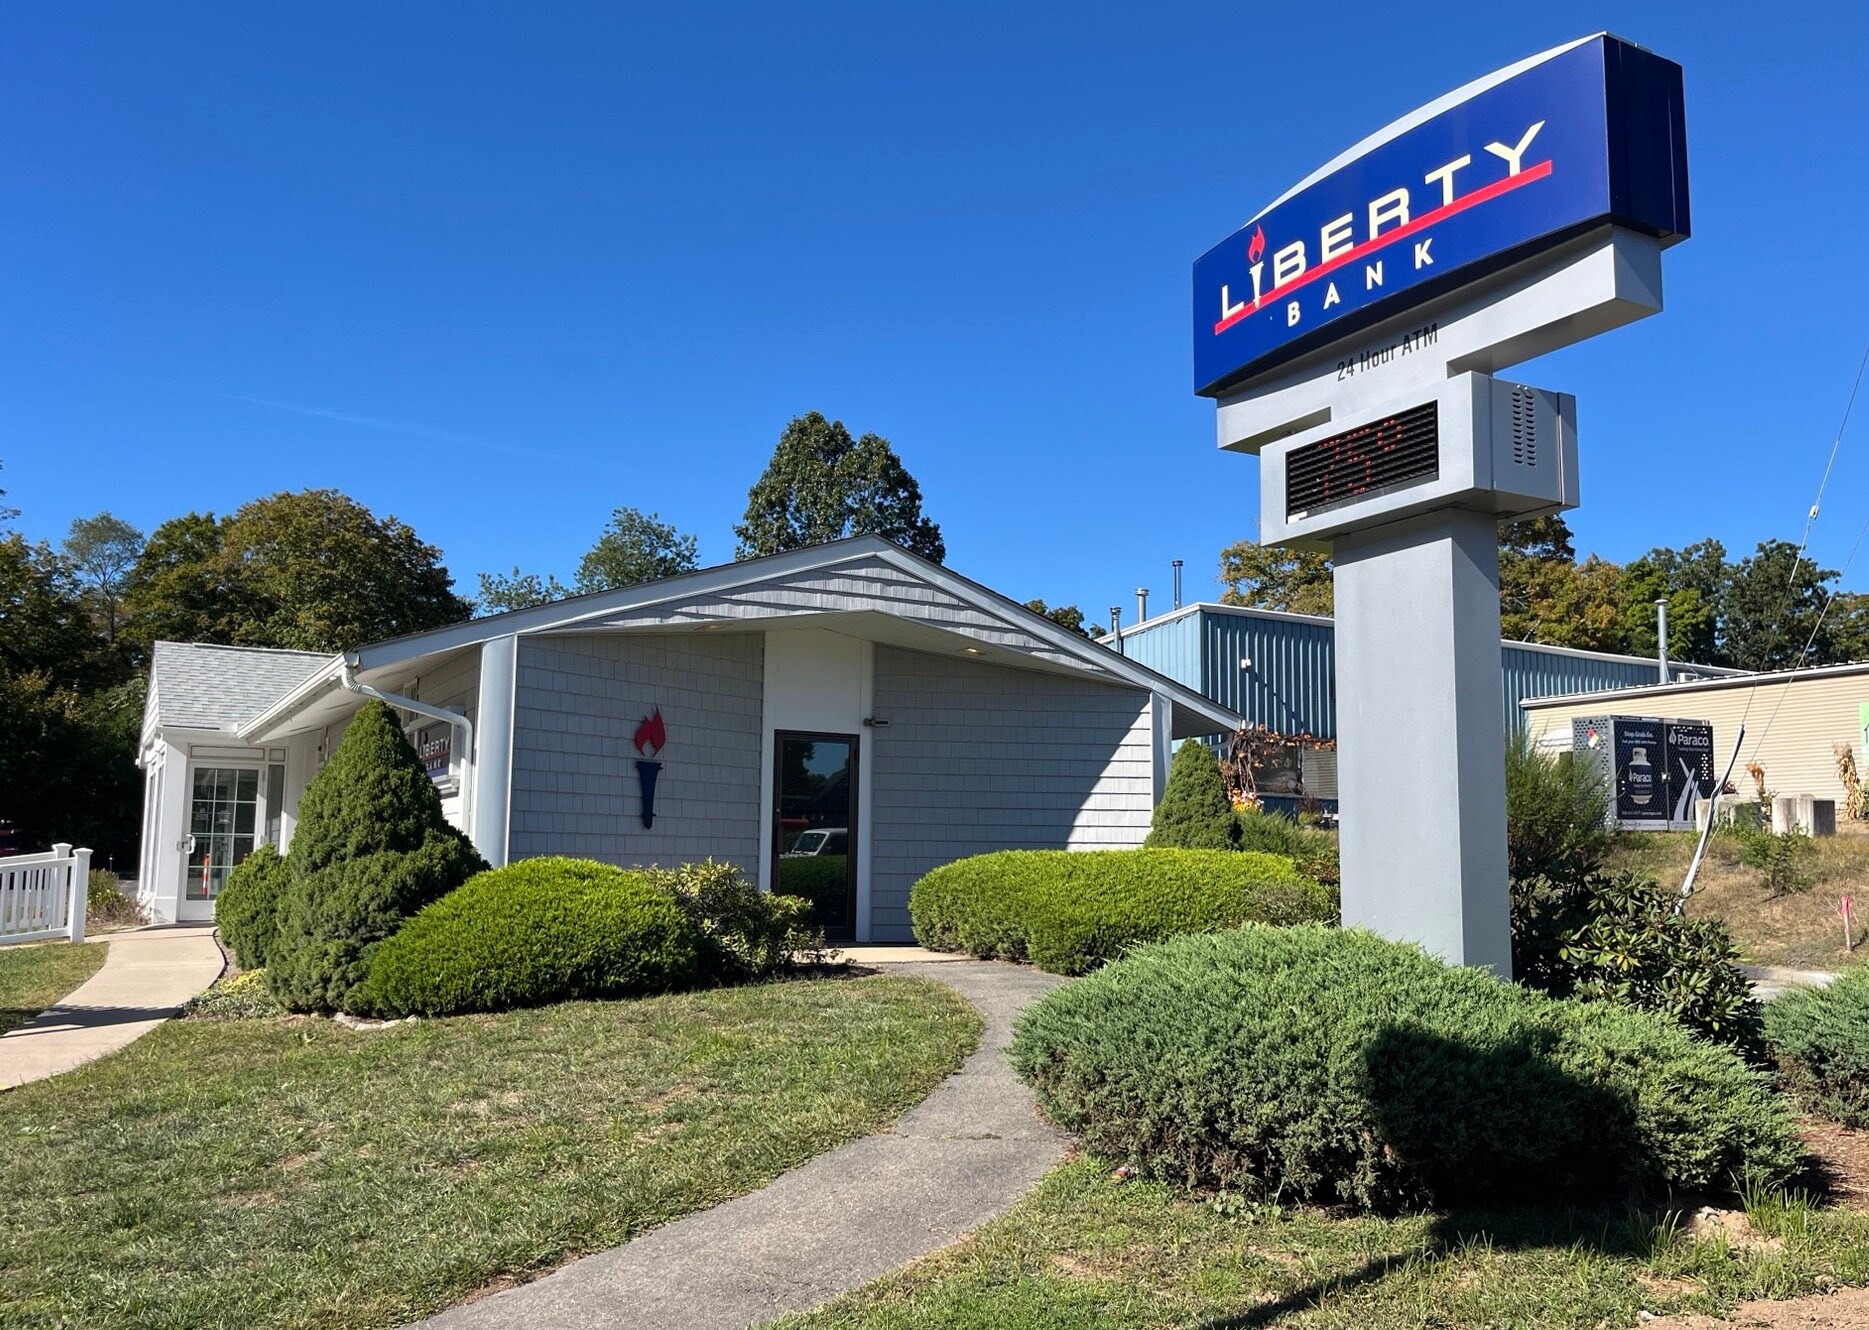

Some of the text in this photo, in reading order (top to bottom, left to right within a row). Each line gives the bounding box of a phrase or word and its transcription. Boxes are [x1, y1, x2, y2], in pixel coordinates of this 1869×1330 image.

[1221, 120, 1546, 322] LIBERTY
[1287, 238, 1433, 327] BANK
[1336, 322, 1438, 382] 24 Hour ATM
[419, 736, 450, 759] LIBERTY
[1677, 734, 1709, 746] Paraco
[1633, 773, 1652, 783] Paraco
